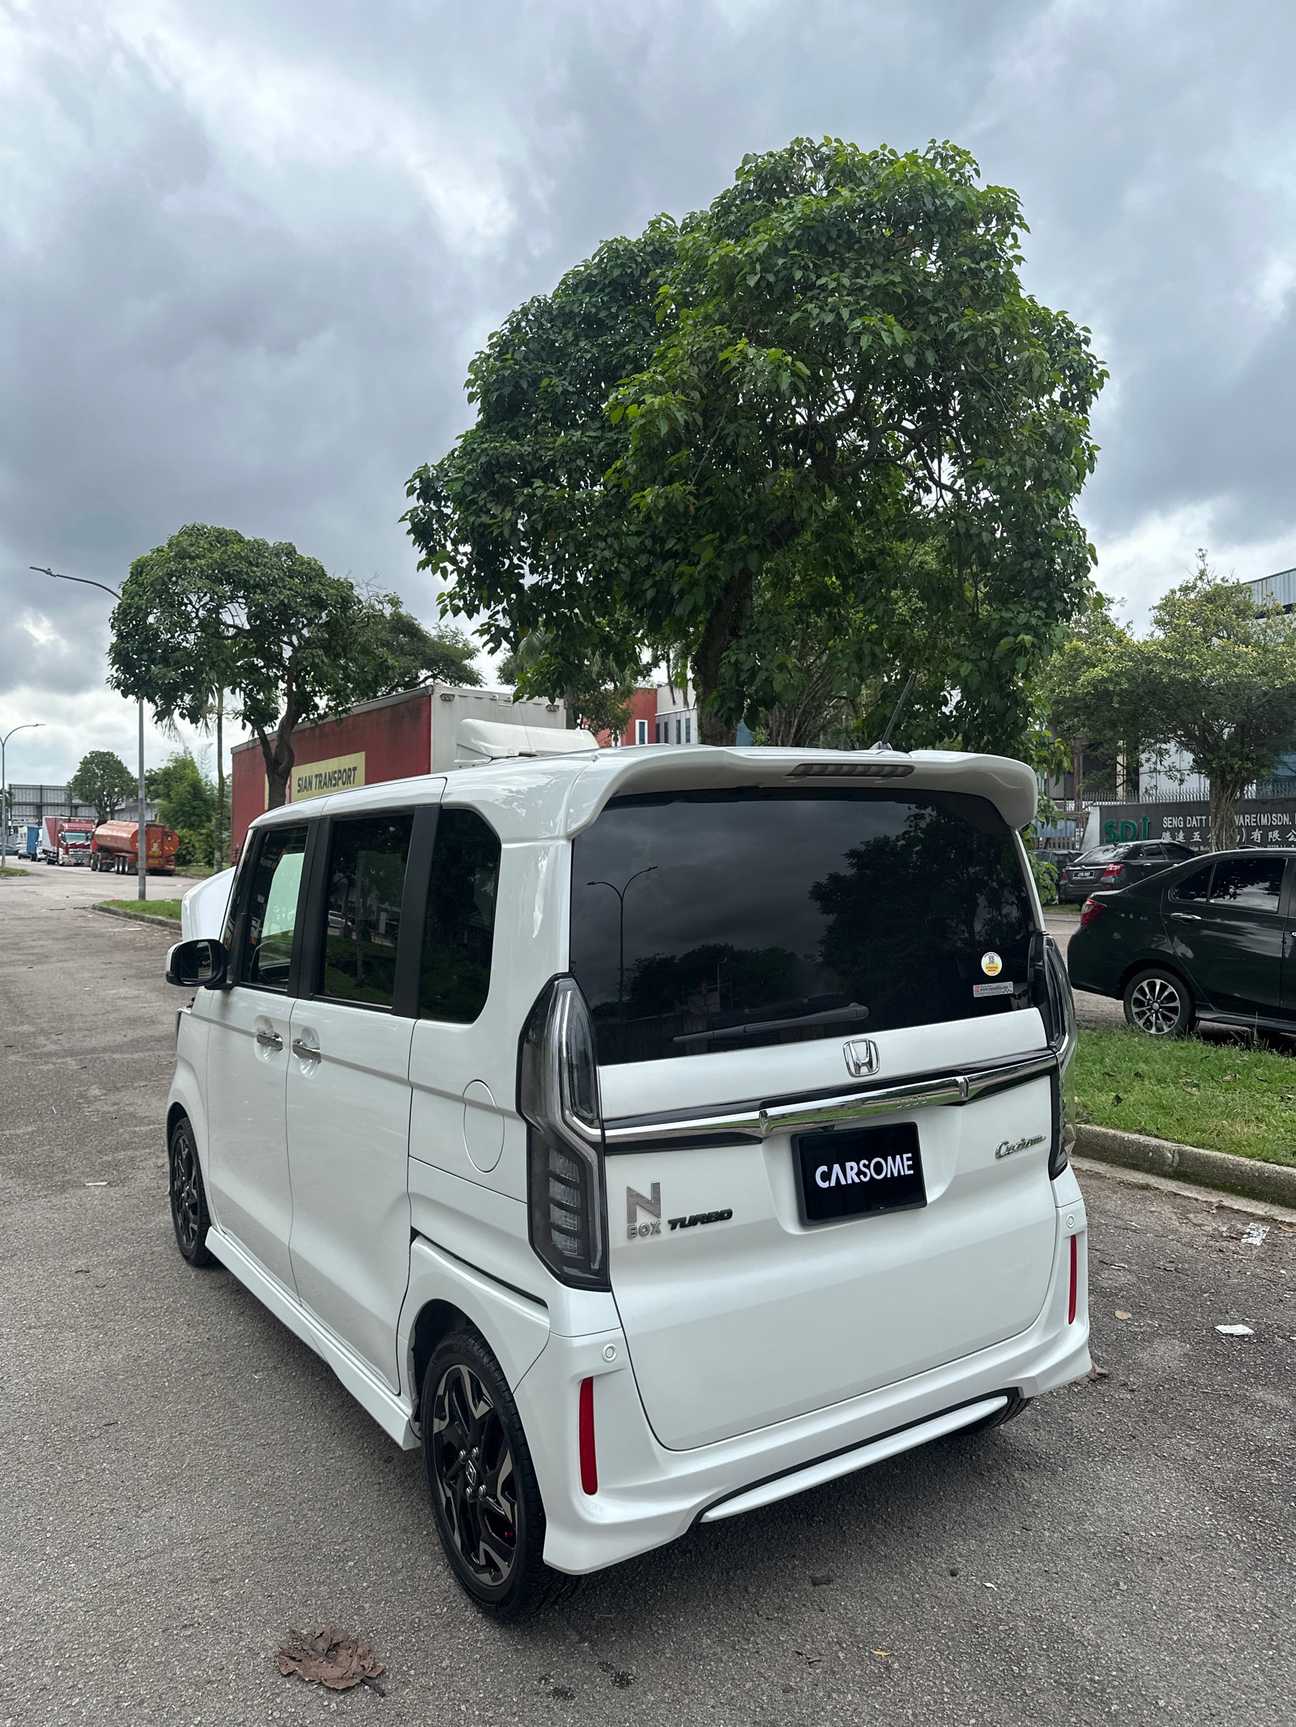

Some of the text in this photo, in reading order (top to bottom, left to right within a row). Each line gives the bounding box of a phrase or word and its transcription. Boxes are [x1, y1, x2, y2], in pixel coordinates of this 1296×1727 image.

[297, 766, 358, 793] SIAN TRANSPORT
[1162, 816, 1184, 828] SENG
[1186, 815, 1207, 828] DATT
[815, 1153, 914, 1188] CARSOME
[626, 1220, 662, 1240] BOX
[667, 1208, 734, 1231] TURBO
